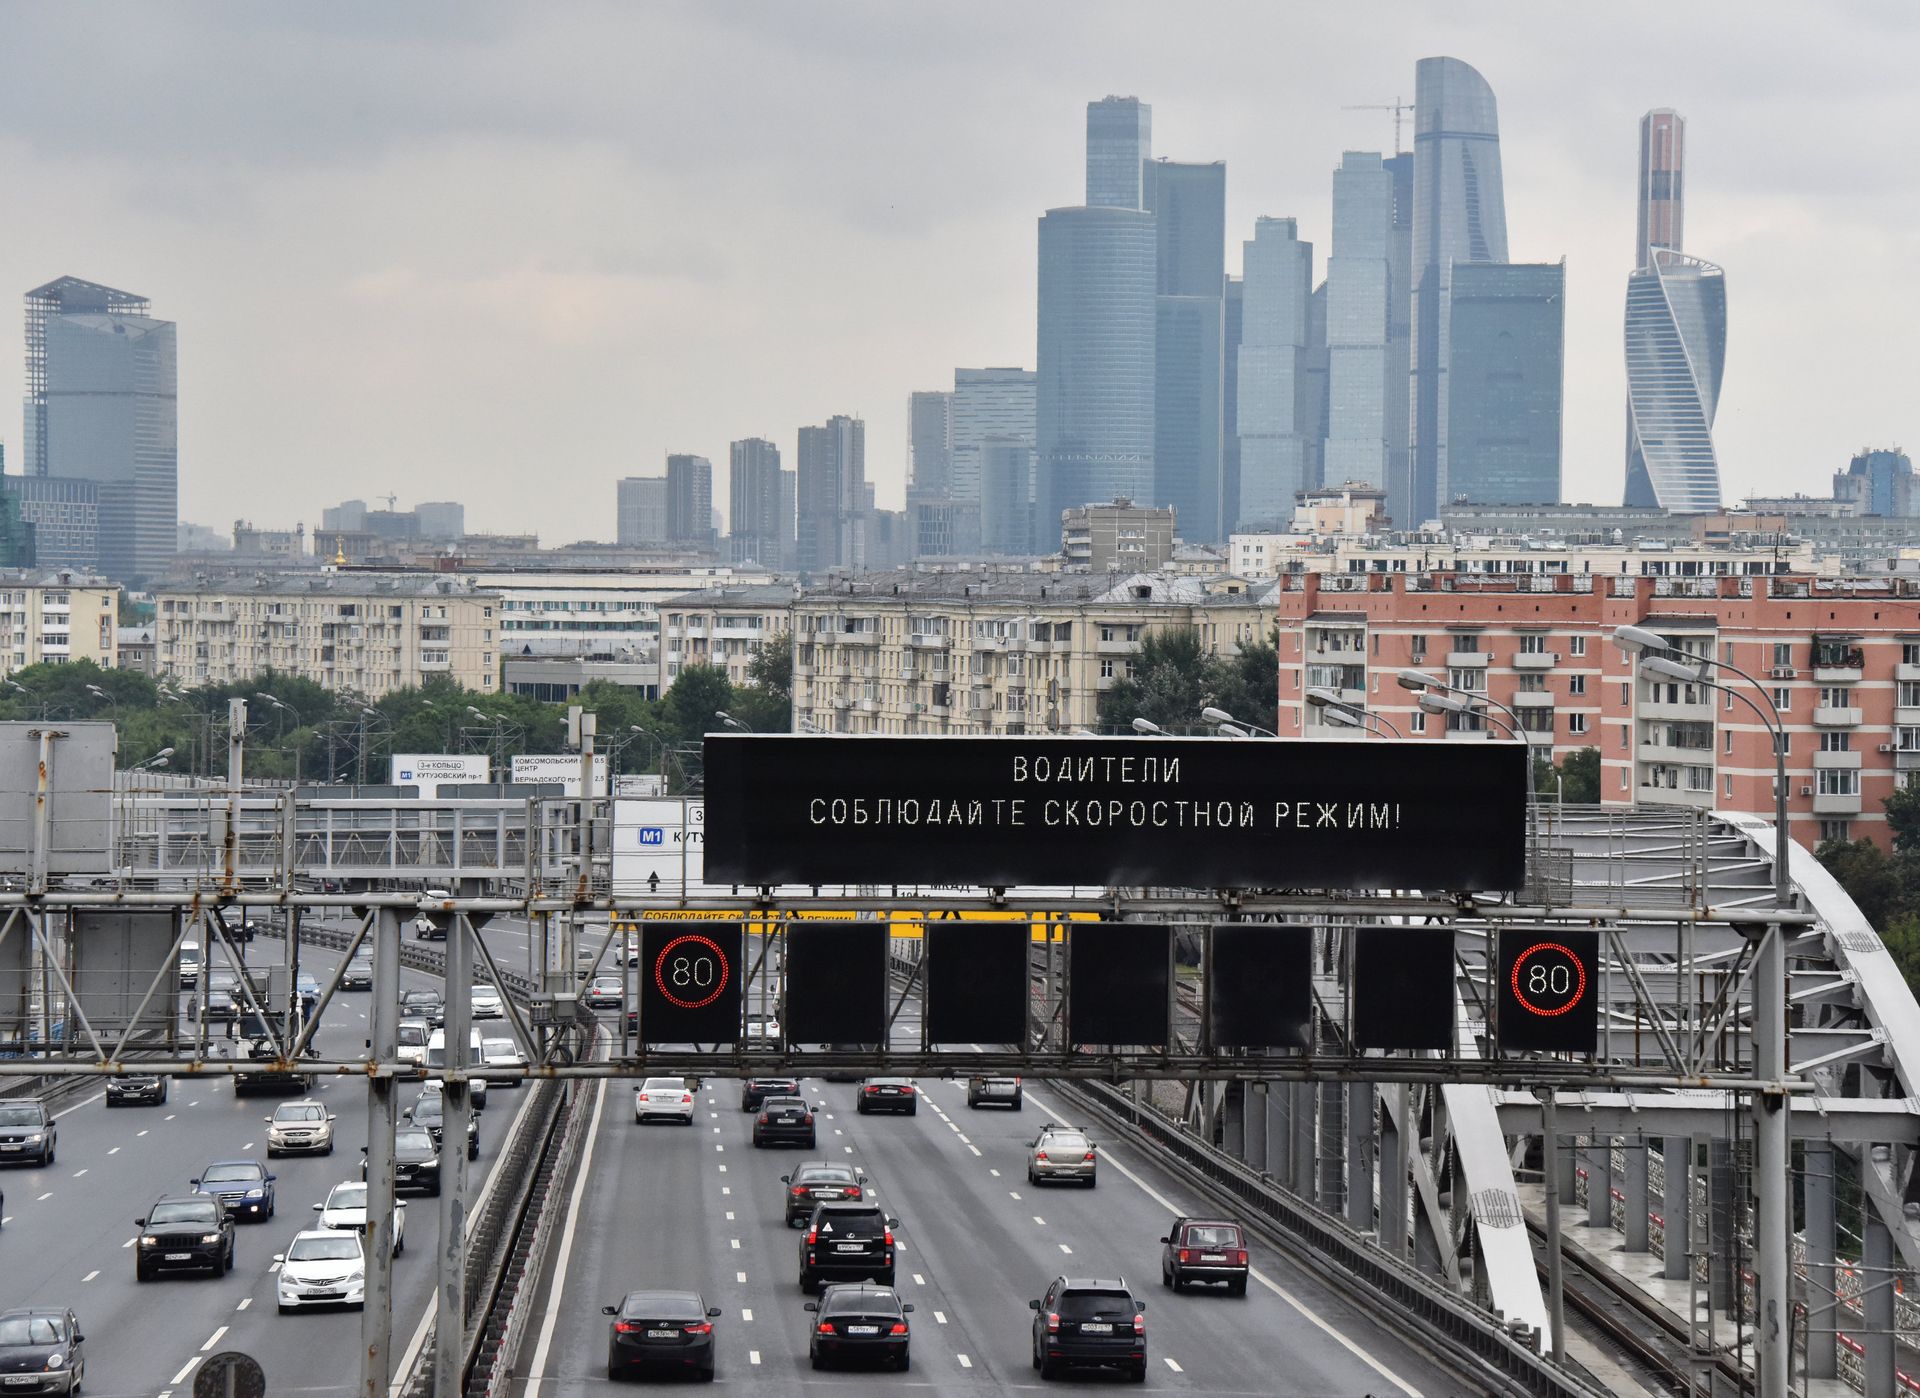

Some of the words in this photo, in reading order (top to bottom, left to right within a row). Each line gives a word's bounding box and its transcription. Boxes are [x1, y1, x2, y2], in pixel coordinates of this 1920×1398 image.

[1012, 756, 1180, 783] ВОДИТЕЛИ
[809, 798, 1025, 825] СОБЛЮДАЙТЕ
[1044, 799, 1255, 828] СКОРОСТНОЙ
[1274, 802, 1402, 829] РЕЖИМ!
[672, 957, 713, 986] 80
[1528, 964, 1569, 994] 80
